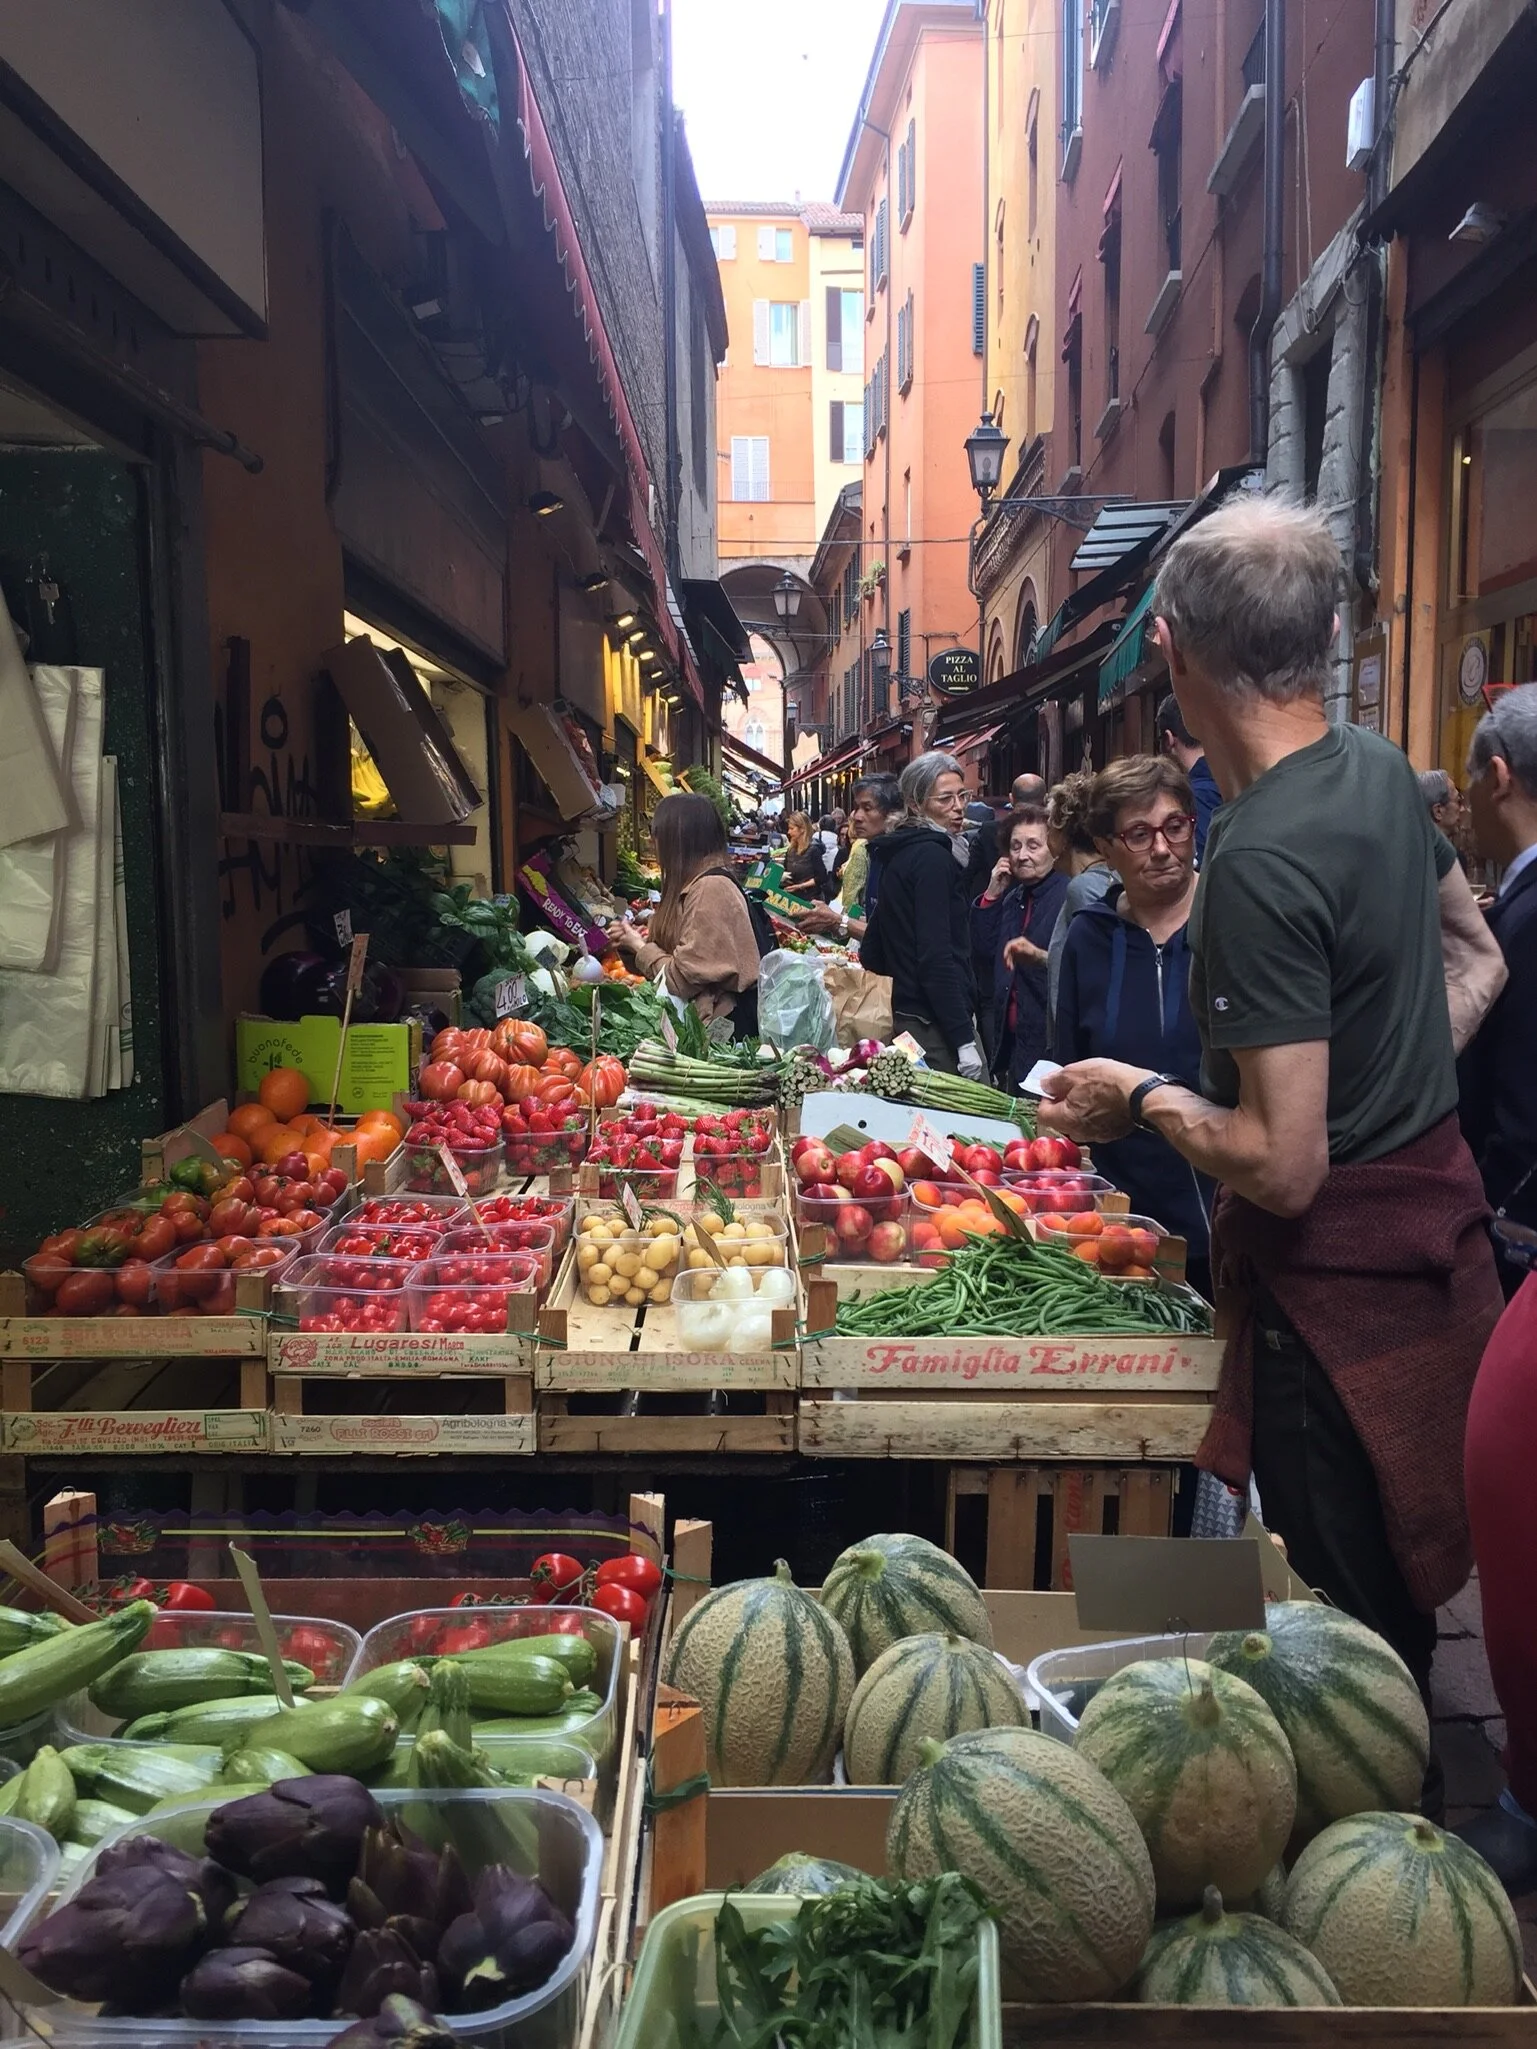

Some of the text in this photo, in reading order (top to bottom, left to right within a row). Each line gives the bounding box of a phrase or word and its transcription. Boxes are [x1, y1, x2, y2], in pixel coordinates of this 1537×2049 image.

[945, 656, 973, 664] PIZZA
[953, 665, 966, 673] AL
[941, 674, 978, 683] TAGLIO
[542, 898, 565, 920] READY
[570, 922, 588, 939] EAT
[350, 1336, 437, 1352] Lugaresi
[559, 1353, 656, 1366] GIUNCHI
[866, 1345, 1180, 1380] Famiglia Errani
[442, 1419, 507, 1430] Agribologna
[370, 1428, 412, 1440] ROSSI
